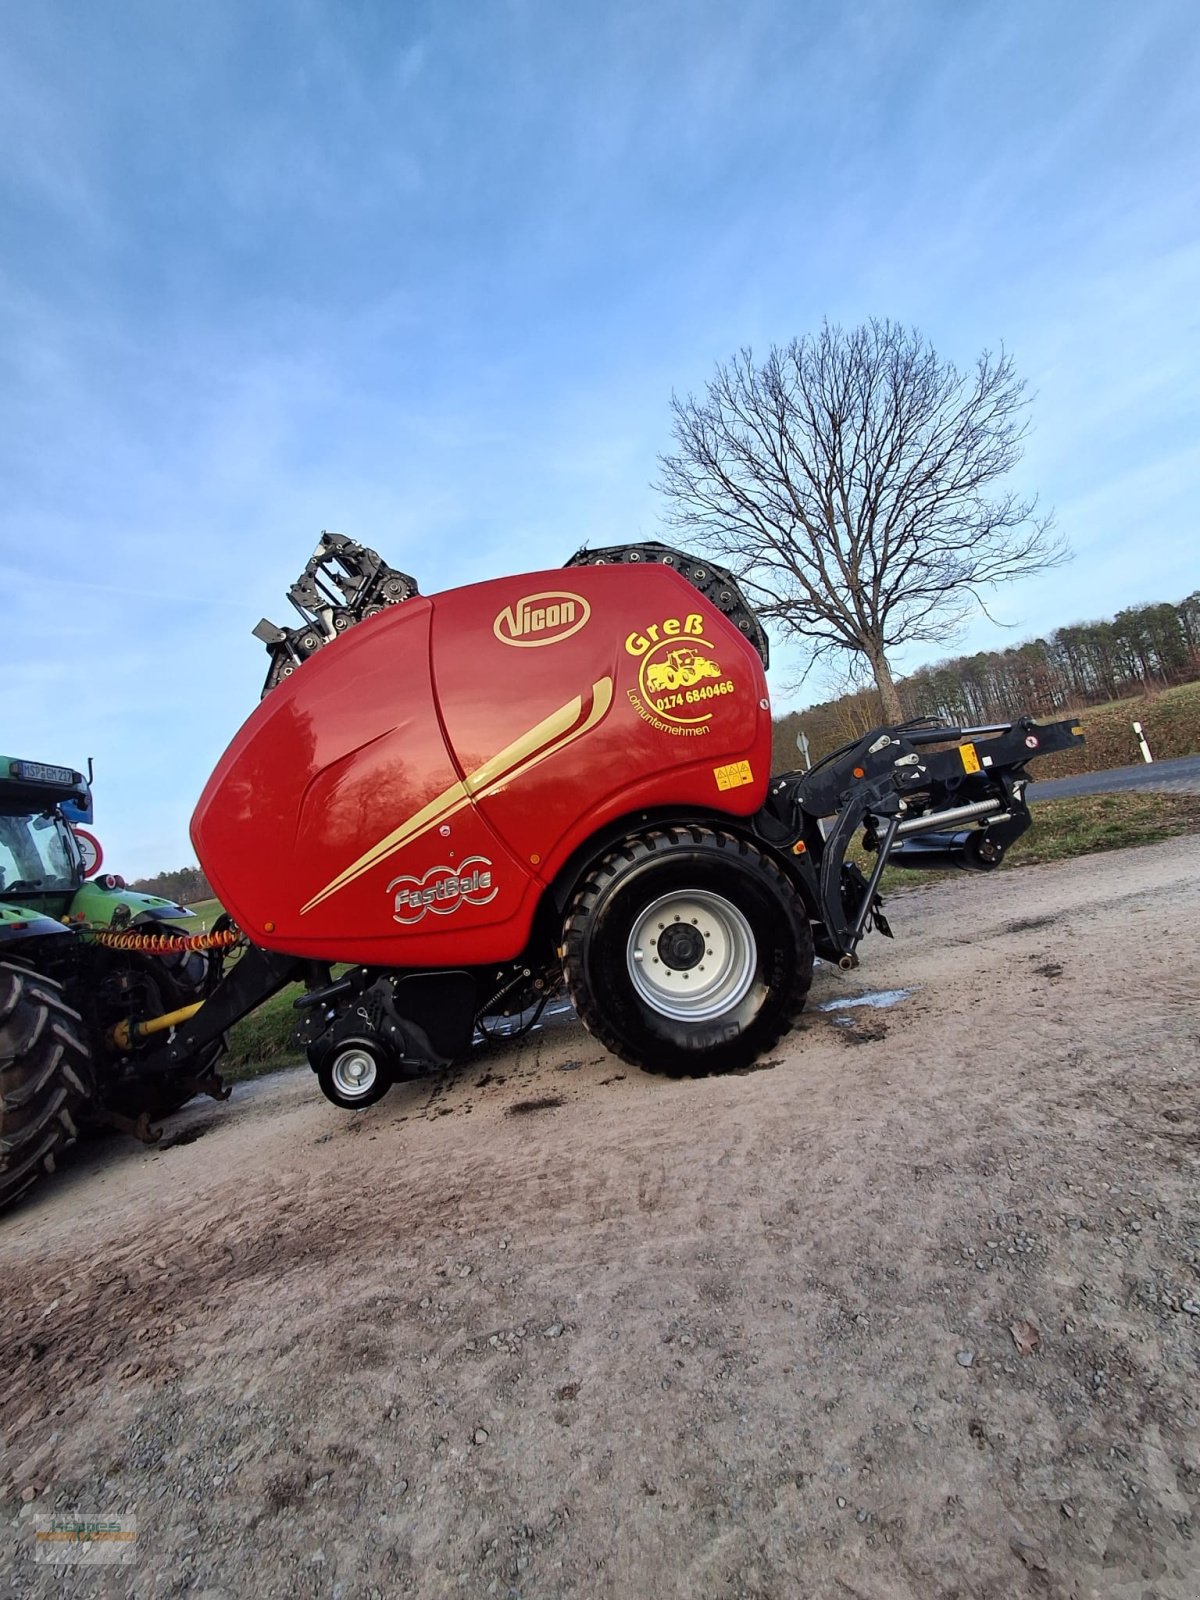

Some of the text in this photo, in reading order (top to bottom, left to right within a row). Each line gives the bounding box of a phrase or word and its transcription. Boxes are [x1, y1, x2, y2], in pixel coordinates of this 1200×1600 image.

[504, 600, 576, 637] Vicon
[625, 614, 704, 656] Greß
[626, 687, 710, 737] Lohnunternehmen
[656, 680, 735, 712] 0174 6840466
[24, 764, 41, 778] MSP
[394, 870, 492, 913] FastBale
